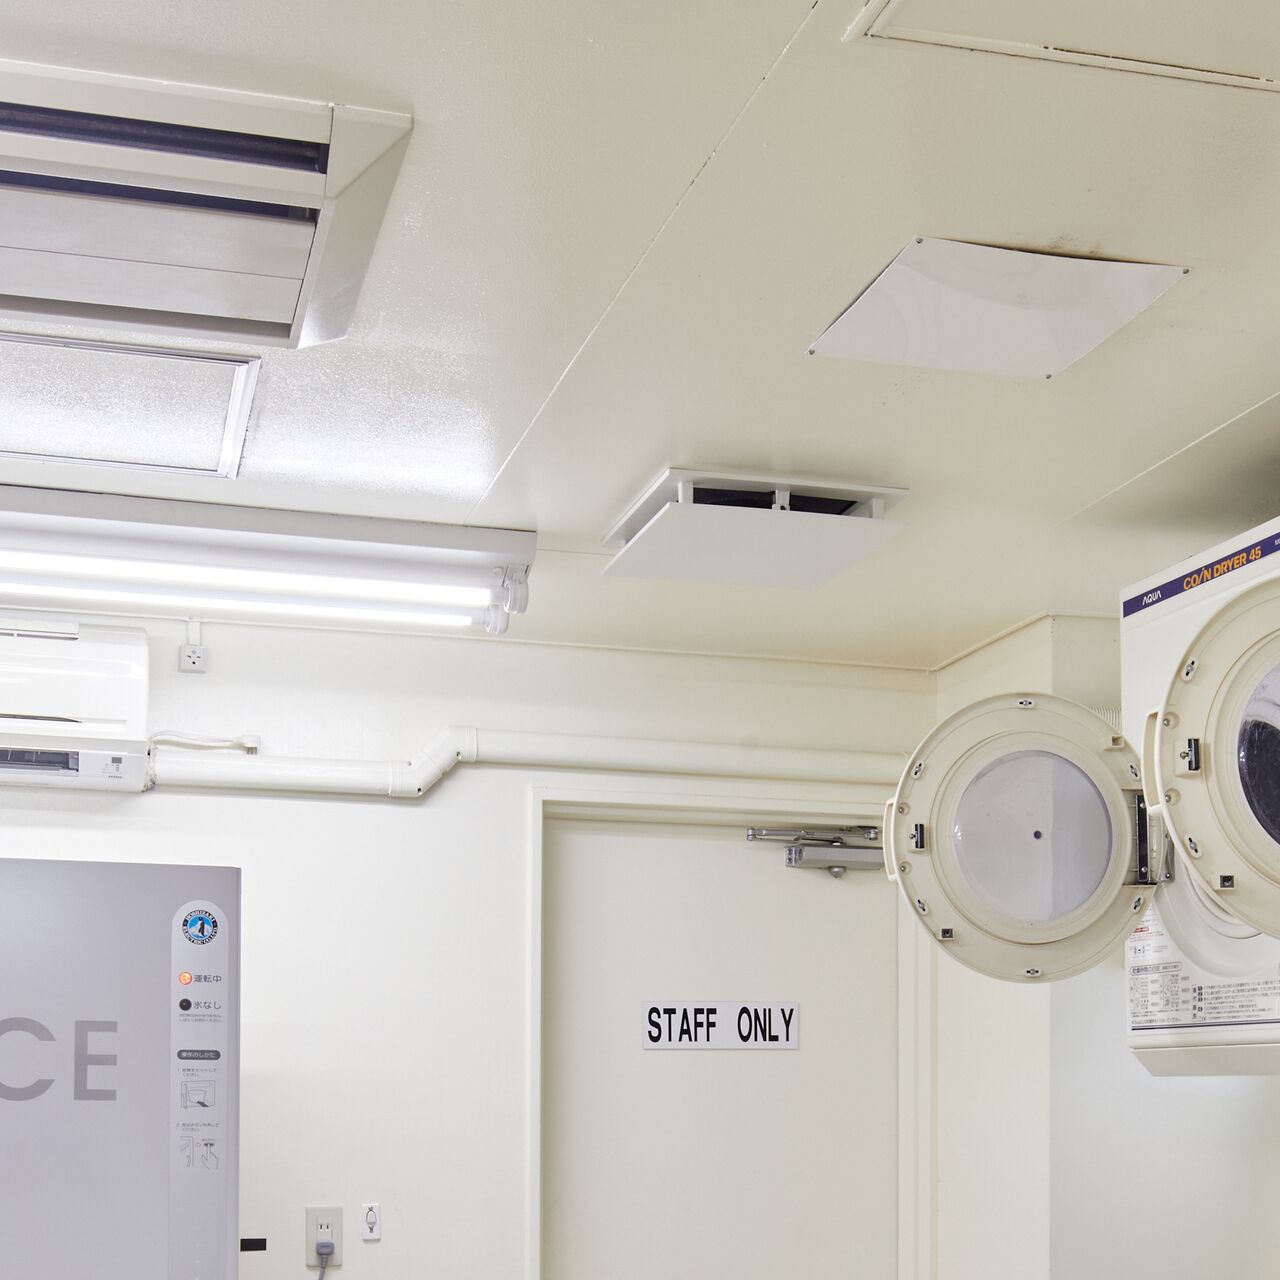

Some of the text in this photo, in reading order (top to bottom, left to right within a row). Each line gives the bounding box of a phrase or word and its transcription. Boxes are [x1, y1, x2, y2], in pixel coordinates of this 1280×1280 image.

[1142, 591, 1161, 605] AQUA
[1214, 555, 1247, 578] DRYER
[1249, 546, 1261, 562] 45
[194, 975, 221, 983] 運転中
[193, 1001, 221, 1009] 氷なし
[648, 1007, 794, 1042] STAFF ONLY
